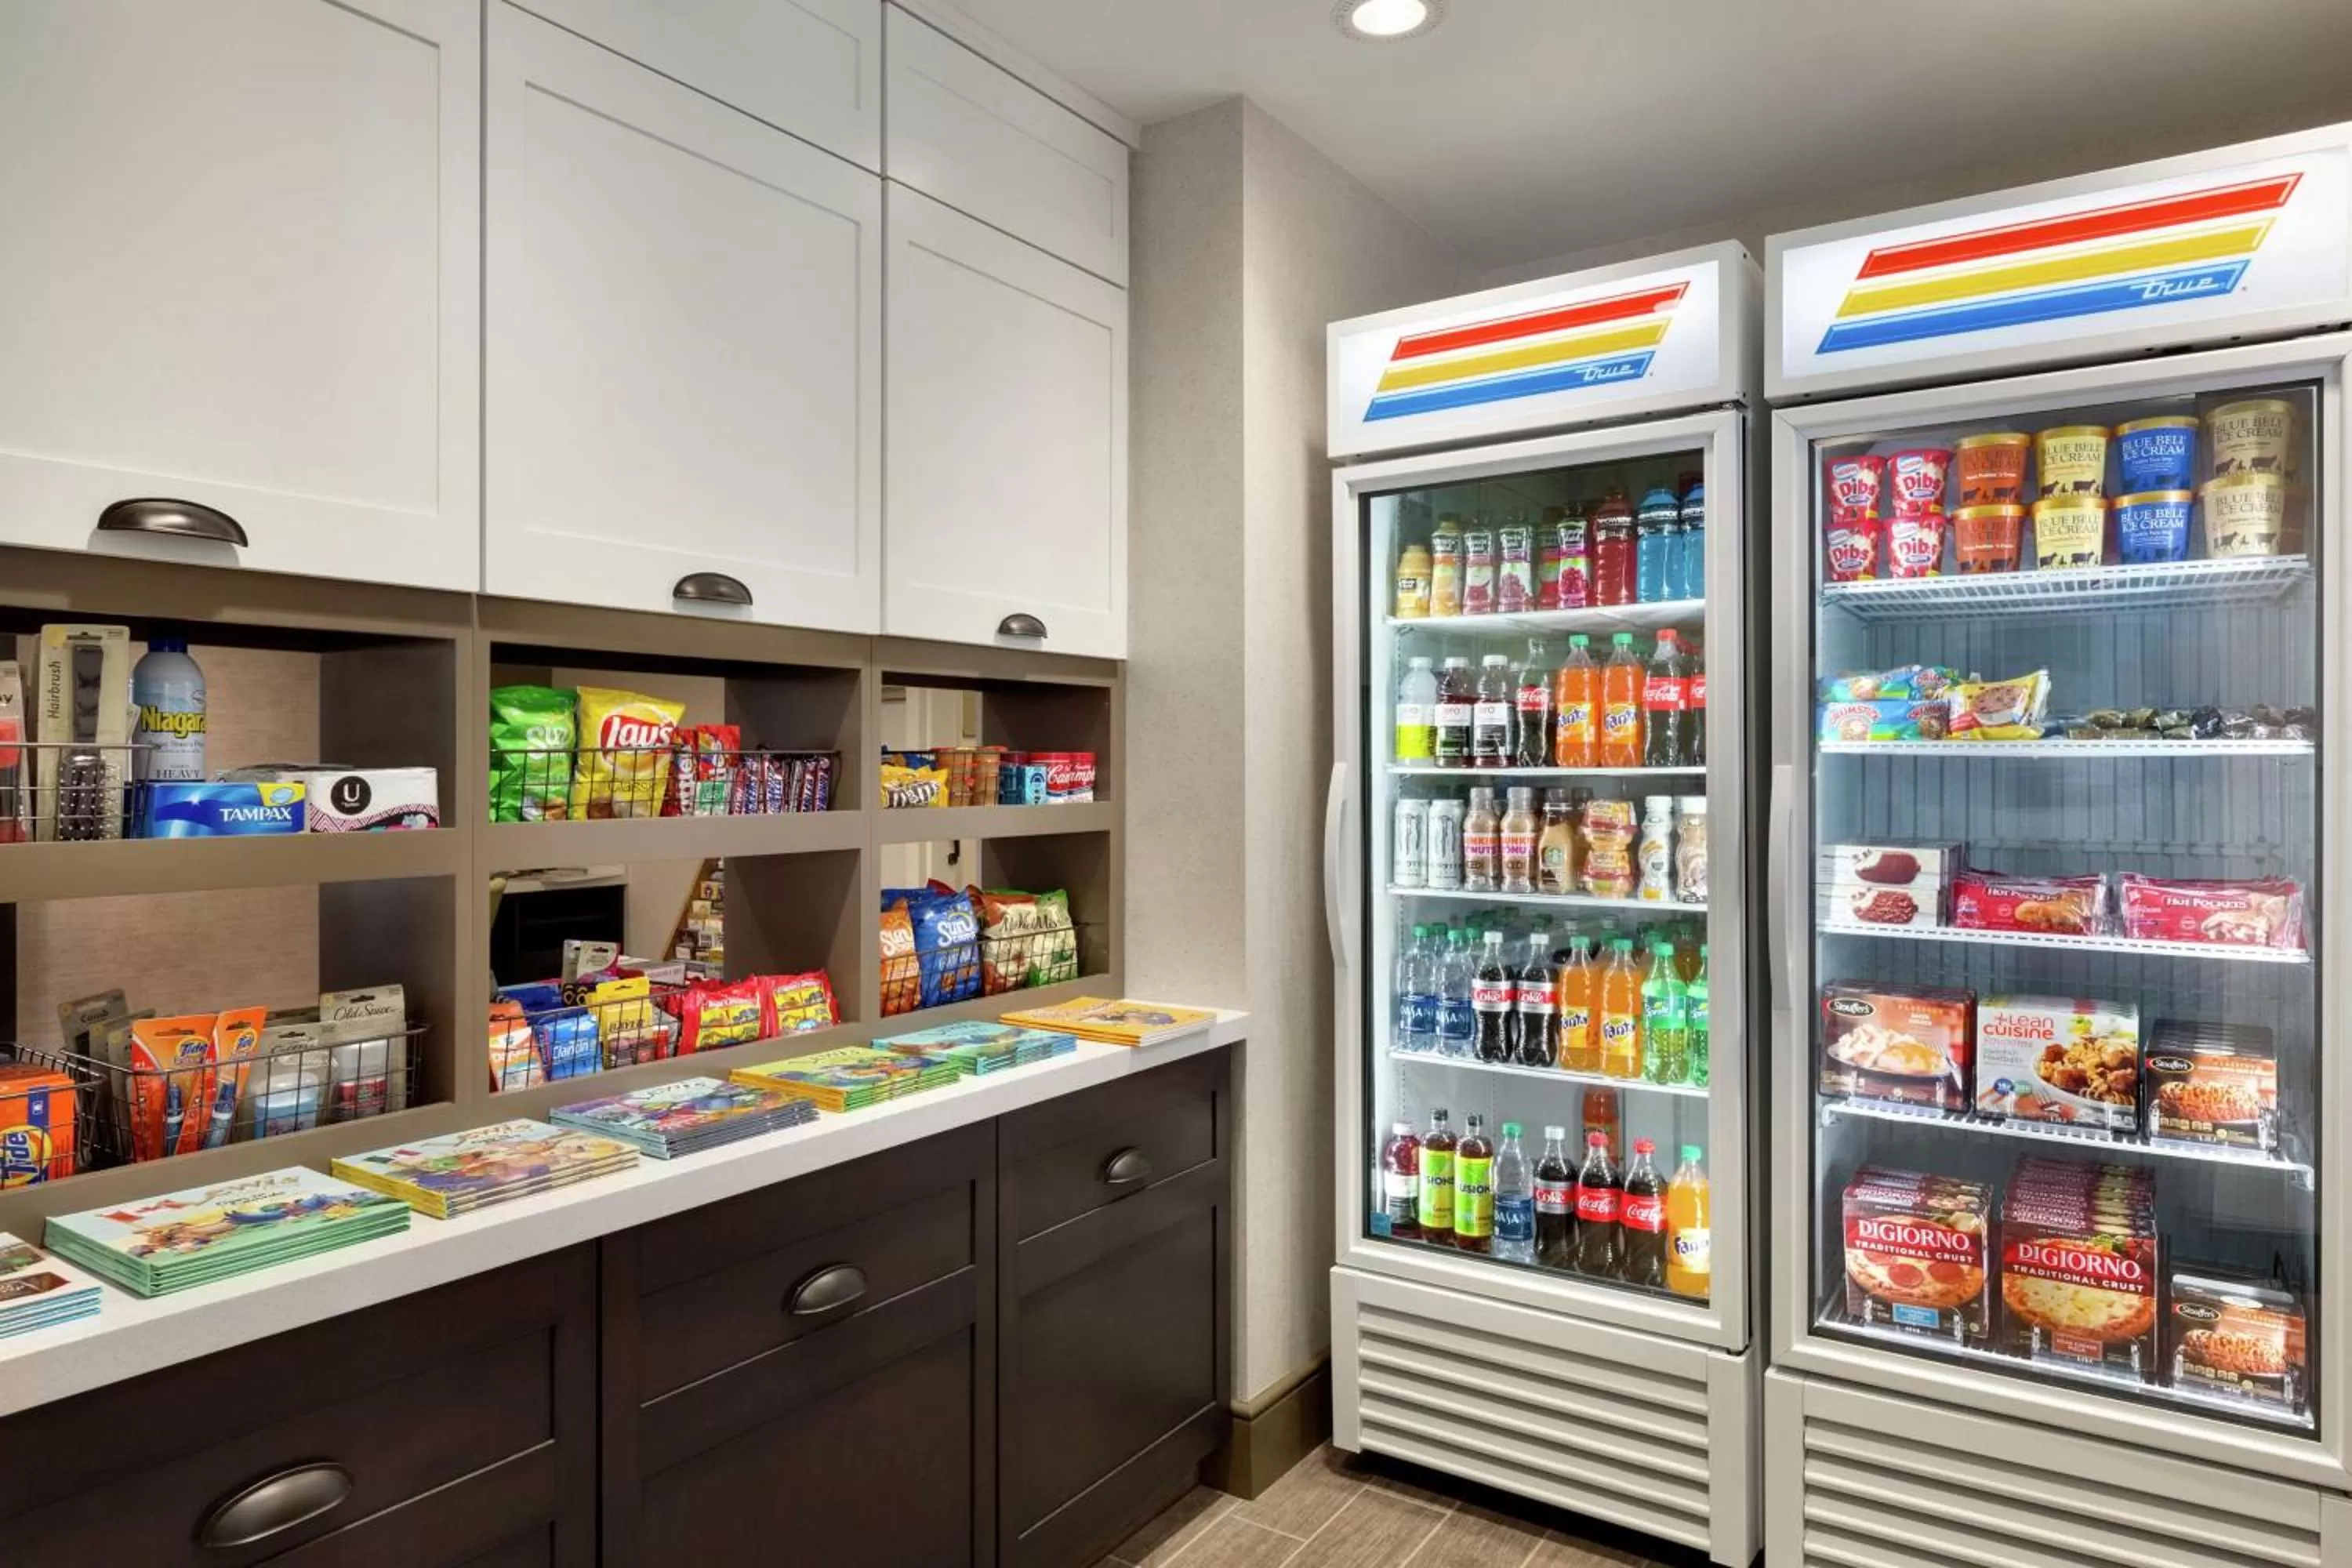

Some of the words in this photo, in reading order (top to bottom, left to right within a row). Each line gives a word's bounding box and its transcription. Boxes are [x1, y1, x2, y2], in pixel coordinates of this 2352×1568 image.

[2156, 434, 2186, 446] BELL
[2141, 444, 2186, 456] CREAM
[1838, 478, 1877, 496] Dibs
[1902, 470, 1944, 492] Dibs
[2156, 508, 2186, 519] BELL
[2140, 517, 2184, 530] CREAM
[1831, 543, 1871, 561] Dibs
[1899, 538, 1940, 557] Dibs
[47, 660, 62, 719] Hairbrush
[156, 768, 201, 779] HEAVY
[343, 784, 361, 803] U
[219, 807, 293, 823] TAMPAX
[1854, 1240, 1931, 1259] TRADITIONAL
[1936, 1252, 1974, 1264] CRUST
[2013, 1264, 2097, 1286] TRADITIONAL
[2102, 1279, 2144, 1293] CRUST
